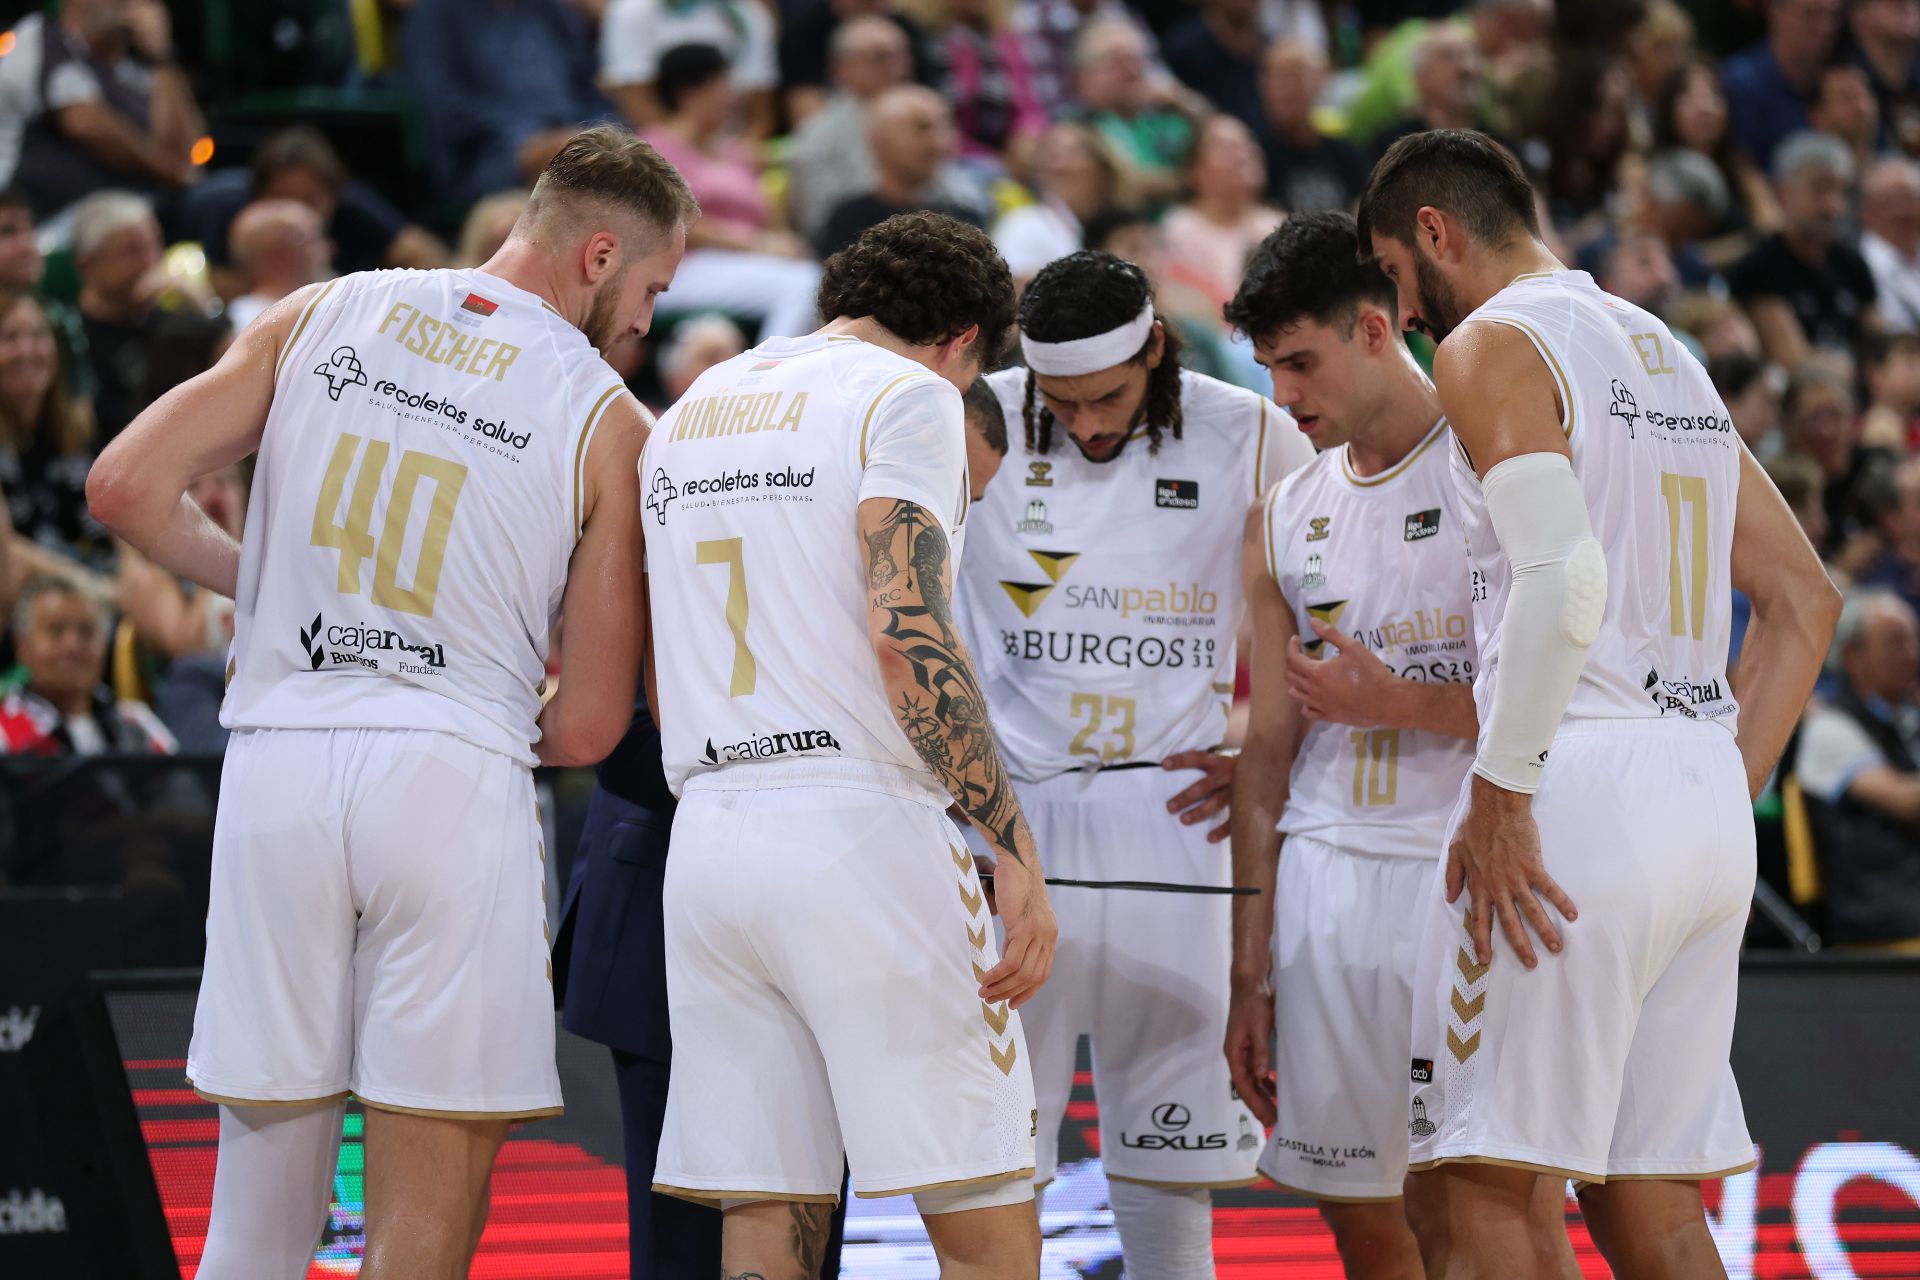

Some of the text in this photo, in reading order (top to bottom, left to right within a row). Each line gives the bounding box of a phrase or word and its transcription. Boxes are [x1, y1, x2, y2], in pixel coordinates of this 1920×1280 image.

[377, 302, 521, 382] FISCHER
[374, 380, 532, 449] recoletas salud
[682, 466, 815, 496] recoletas salud
[310, 432, 468, 618] 40
[696, 537, 757, 698] 7
[1023, 630, 1185, 669] BURGOS
[1069, 692, 1137, 762] 23
[1349, 729, 1399, 807] 10
[1412, 1067, 1428, 1080] acb
[1121, 1131, 1228, 1151] LEXUS
[1278, 1137, 1376, 1159] CASTILLA Y LEÓN
